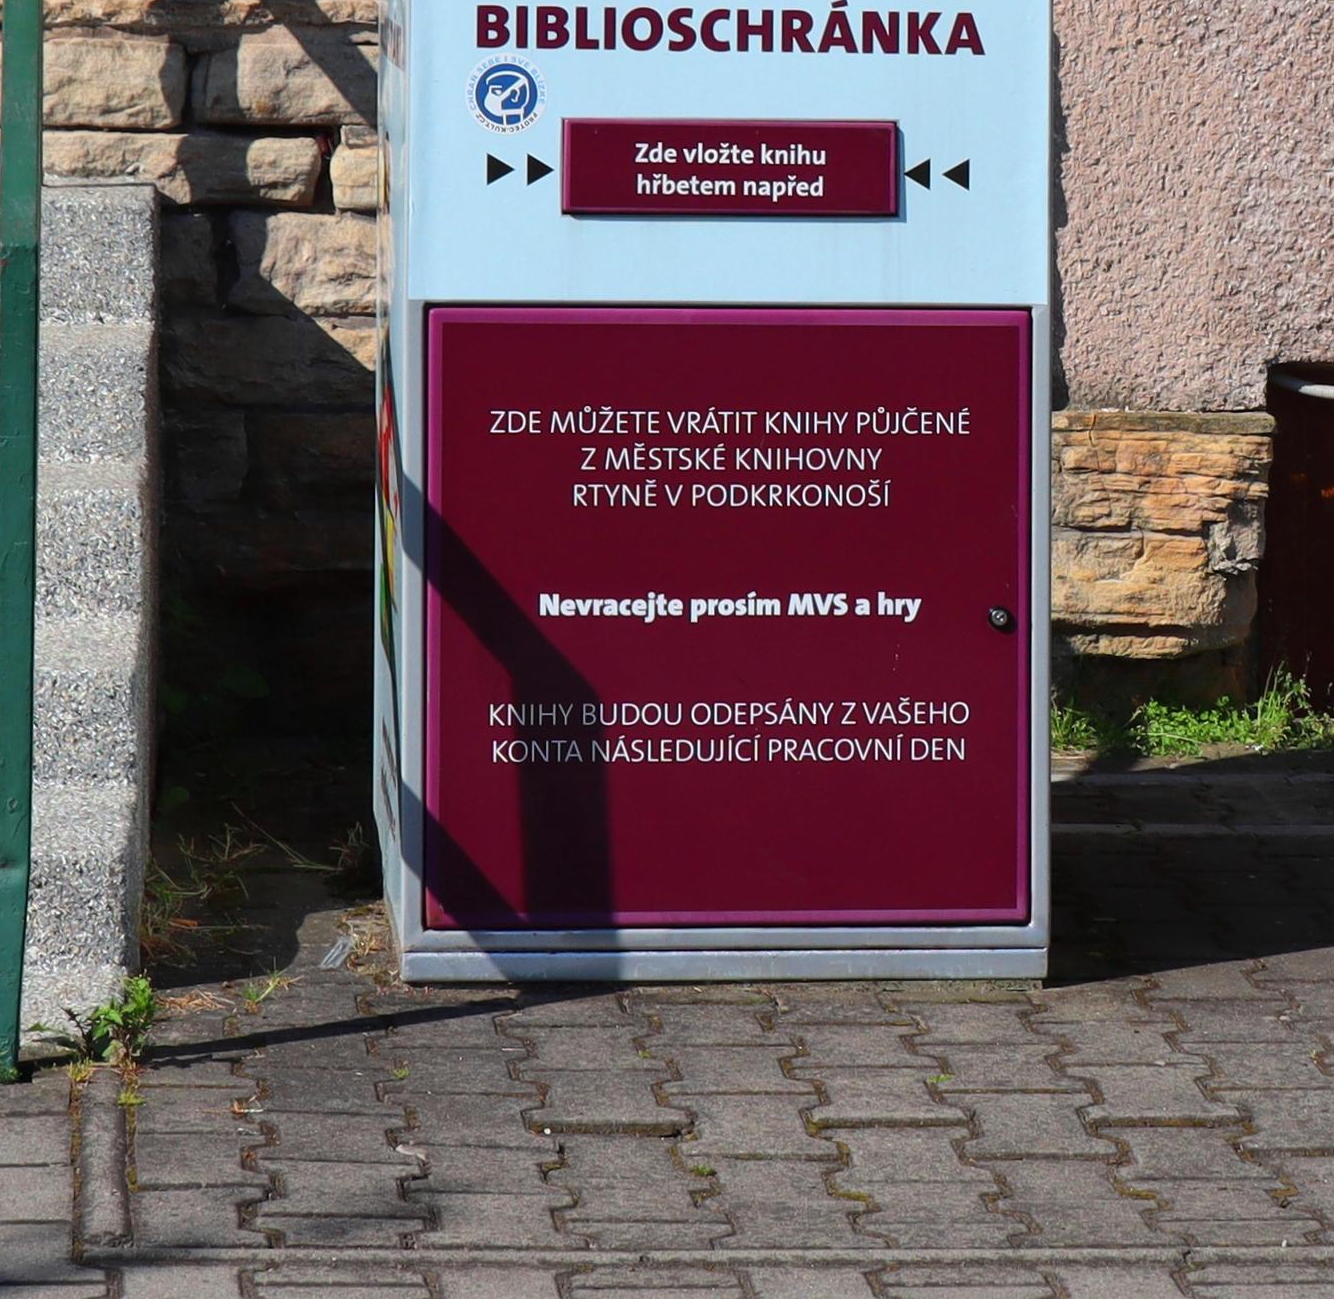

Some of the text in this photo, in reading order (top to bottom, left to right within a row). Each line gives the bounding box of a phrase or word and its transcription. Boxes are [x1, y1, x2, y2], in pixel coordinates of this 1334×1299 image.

[635, 141, 827, 167] Zde vložte knihu
[636, 173, 824, 203] hřbetem napřed
[489, 405, 971, 439] ZDE MŮŽETE VRÁTIT KNIHY PŮJČENÉ
[581, 442, 883, 472] Z MĚSTSKÉ KNIHOVNY
[573, 479, 890, 508] RTYNĚ V PODKRKONOŠÍ
[540, 592, 921, 622] Nevracejte prosím MVS a hry
[489, 695, 970, 727] KNIHY BUDOU ODEPSÁNY Z VAŠEHO
[492, 734, 965, 767] KONTA NÁSLEDUJÍCÍ PRACOVNÍ DEN
